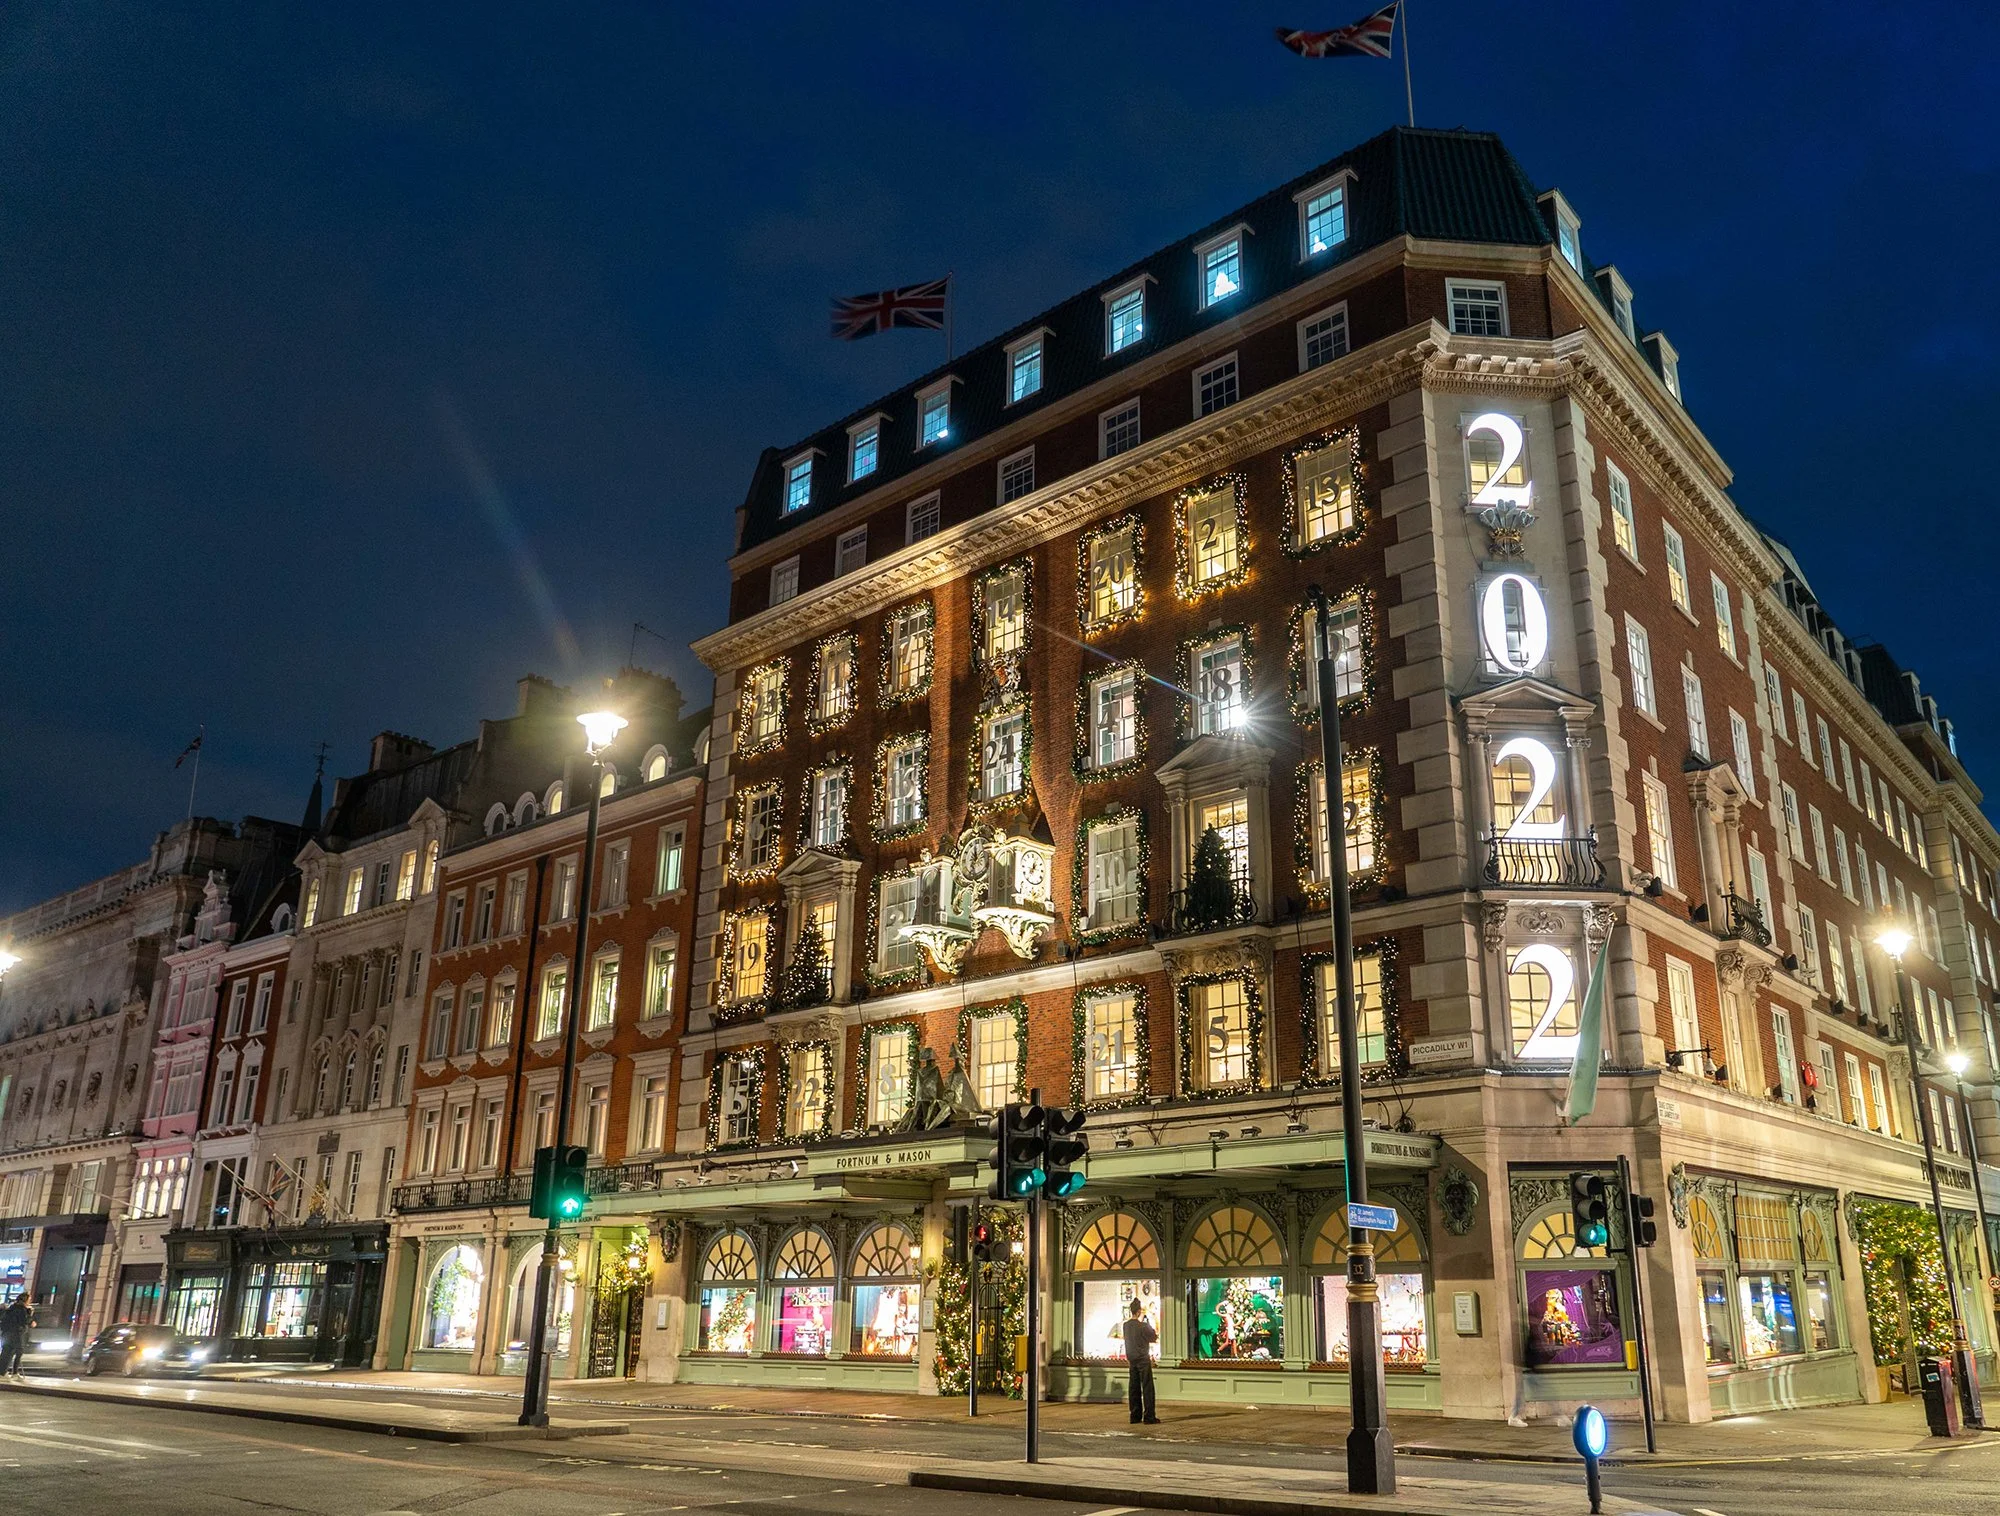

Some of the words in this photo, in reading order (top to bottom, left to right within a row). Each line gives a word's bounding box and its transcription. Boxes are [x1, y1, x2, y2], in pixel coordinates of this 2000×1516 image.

[1201, 518, 1217, 550] 2
[1094, 554, 1126, 590] 20
[987, 597, 1015, 629] 14
[1199, 668, 1233, 706] 18
[752, 690, 778, 720] 23
[1098, 699, 1121, 735] 4
[985, 736, 1016, 771] 24
[750, 814, 765, 840] 6
[1096, 853, 1125, 893] 10
[738, 943, 760, 971] 19
[1092, 1029, 1126, 1067] 21
[1206, 1016, 1229, 1054] 5
[1412, 1042, 1456, 1055] PICCADILLY
[1457, 1041, 1468, 1049] W1
[791, 1077, 820, 1109] 22
[879, 1064, 896, 1095] 8
[836, 1154, 879, 1168] FORTNUM
[886, 1154, 892, 1164] &
[898, 1150, 931, 1163] MASON
